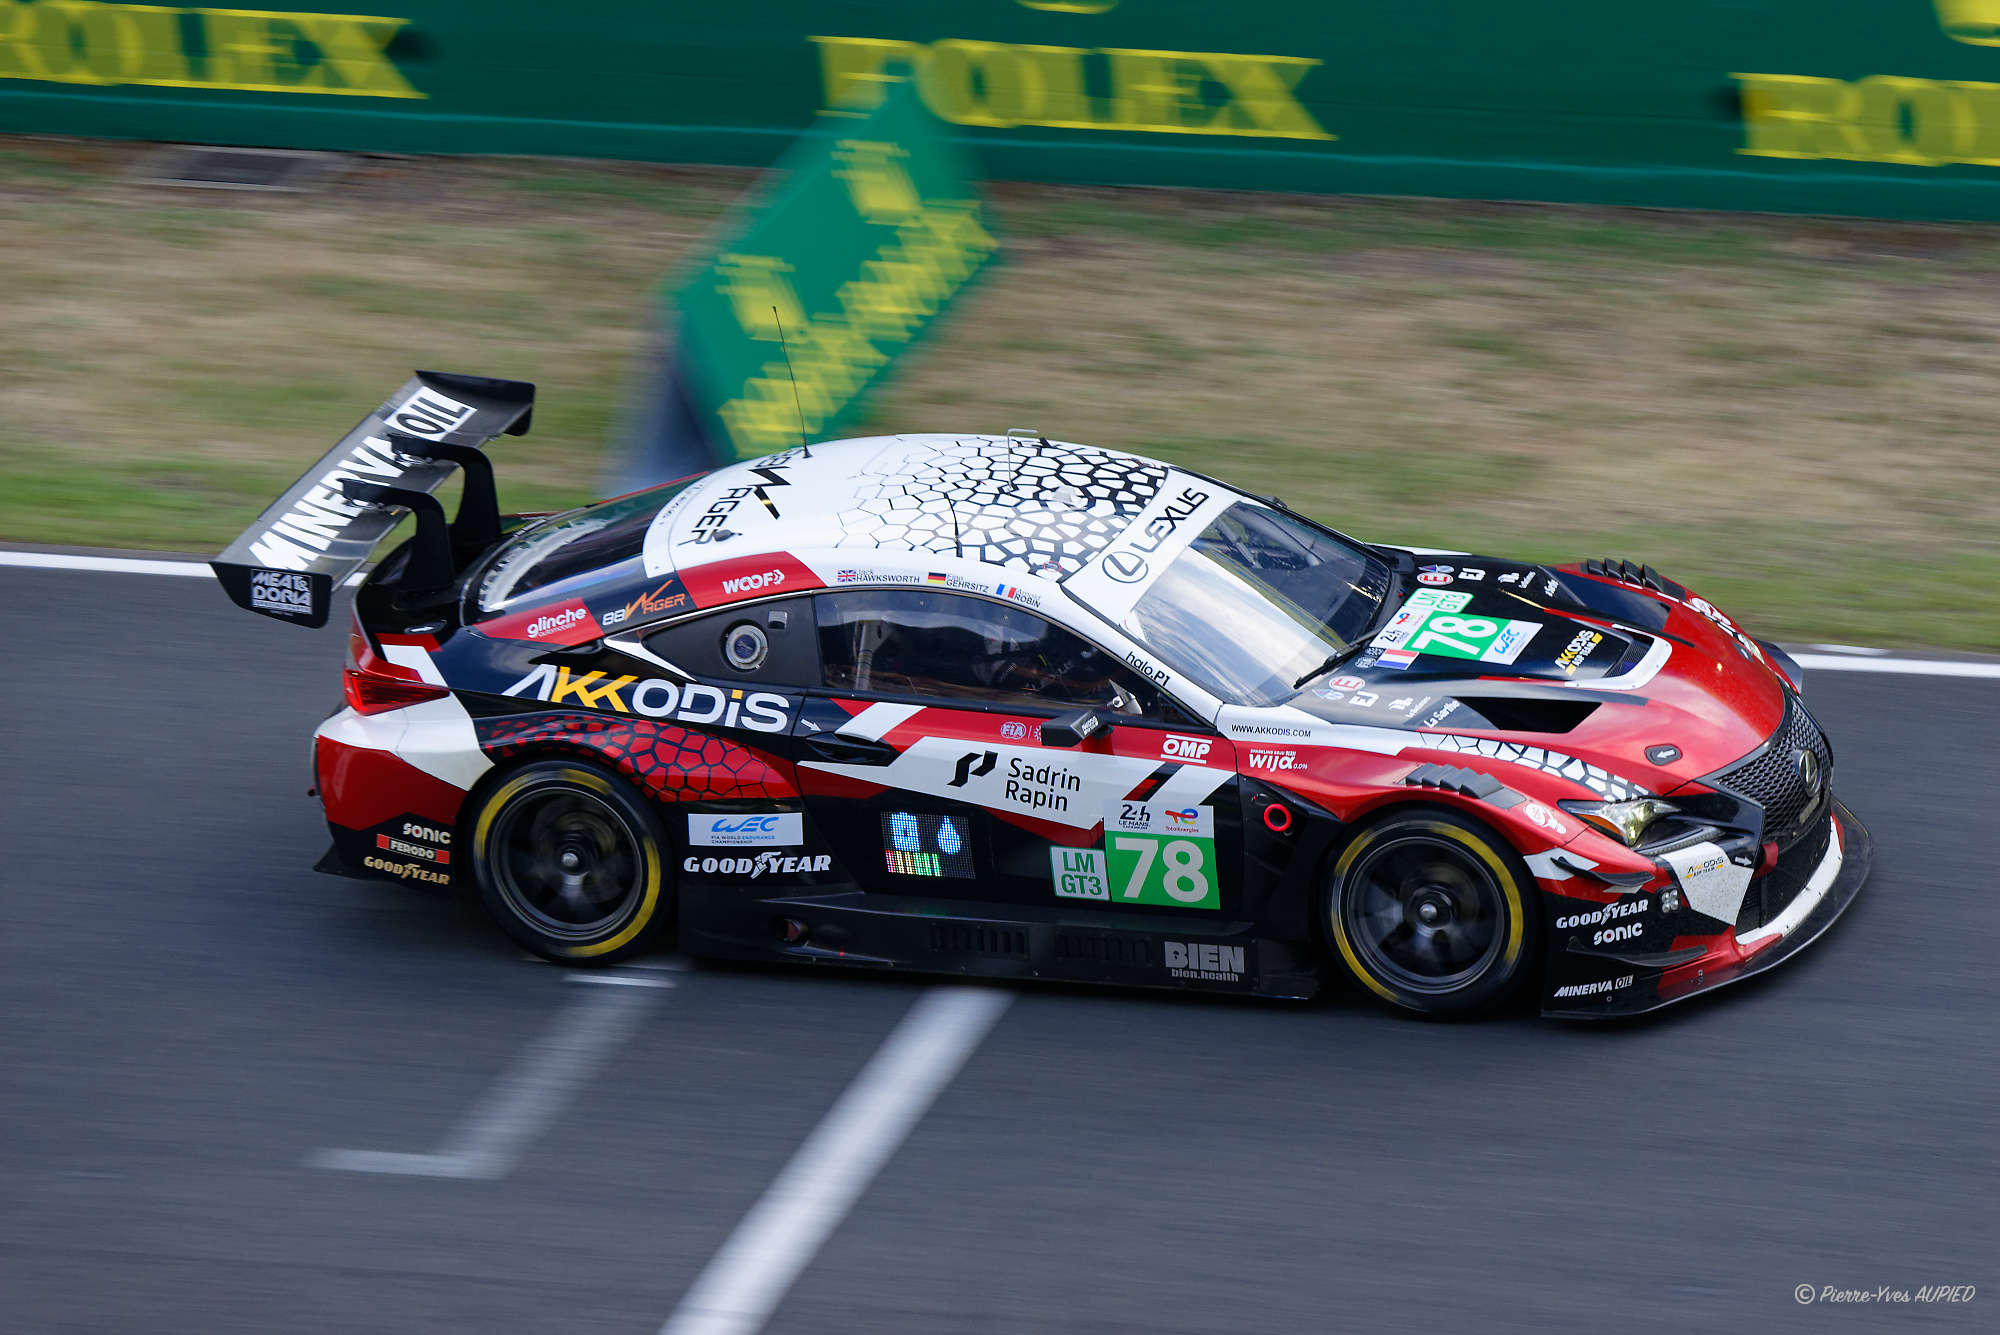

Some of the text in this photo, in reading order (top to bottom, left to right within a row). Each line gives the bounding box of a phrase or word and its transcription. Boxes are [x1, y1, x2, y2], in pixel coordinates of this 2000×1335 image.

[396, 397, 470, 435] OIL
[1130, 487, 1209, 552] LEXUS
[723, 574, 776, 594] WOOF
[856, 574, 920, 583] HAWKSWORTH
[946, 580, 990, 593] GEHRSITZ
[252, 585, 311, 606] DORIA
[1014, 594, 1041, 608] ROBIN
[527, 608, 587, 638] glinche
[1411, 616, 1498, 656] 78
[1494, 628, 1520, 655] WEC
[1125, 651, 1170, 687] halo.P1
[501, 664, 789, 733] AKKODIS
[1423, 716, 1440, 728] La
[1433, 700, 1461, 721] Sarthe
[1001, 723, 1025, 738] FIA
[1231, 724, 1312, 738] WWW.AKKODIS.COM
[1163, 738, 1211, 759] OMP
[1007, 757, 1081, 792] Sadrin
[1249, 753, 1296, 773] wija
[1005, 780, 1068, 812] Rapin
[402, 822, 452, 844] SONIC
[711, 816, 779, 832] WEC
[390, 840, 435, 859] FERODO
[1062, 851, 1096, 874] LM
[1115, 837, 1209, 903] 78
[1060, 874, 1103, 896] GT3
[1593, 922, 1643, 945] SONIC
[1164, 941, 1245, 973] BIEN
[1171, 968, 1239, 983] bien.health
[1553, 974, 1634, 998] MINERVA OIL
